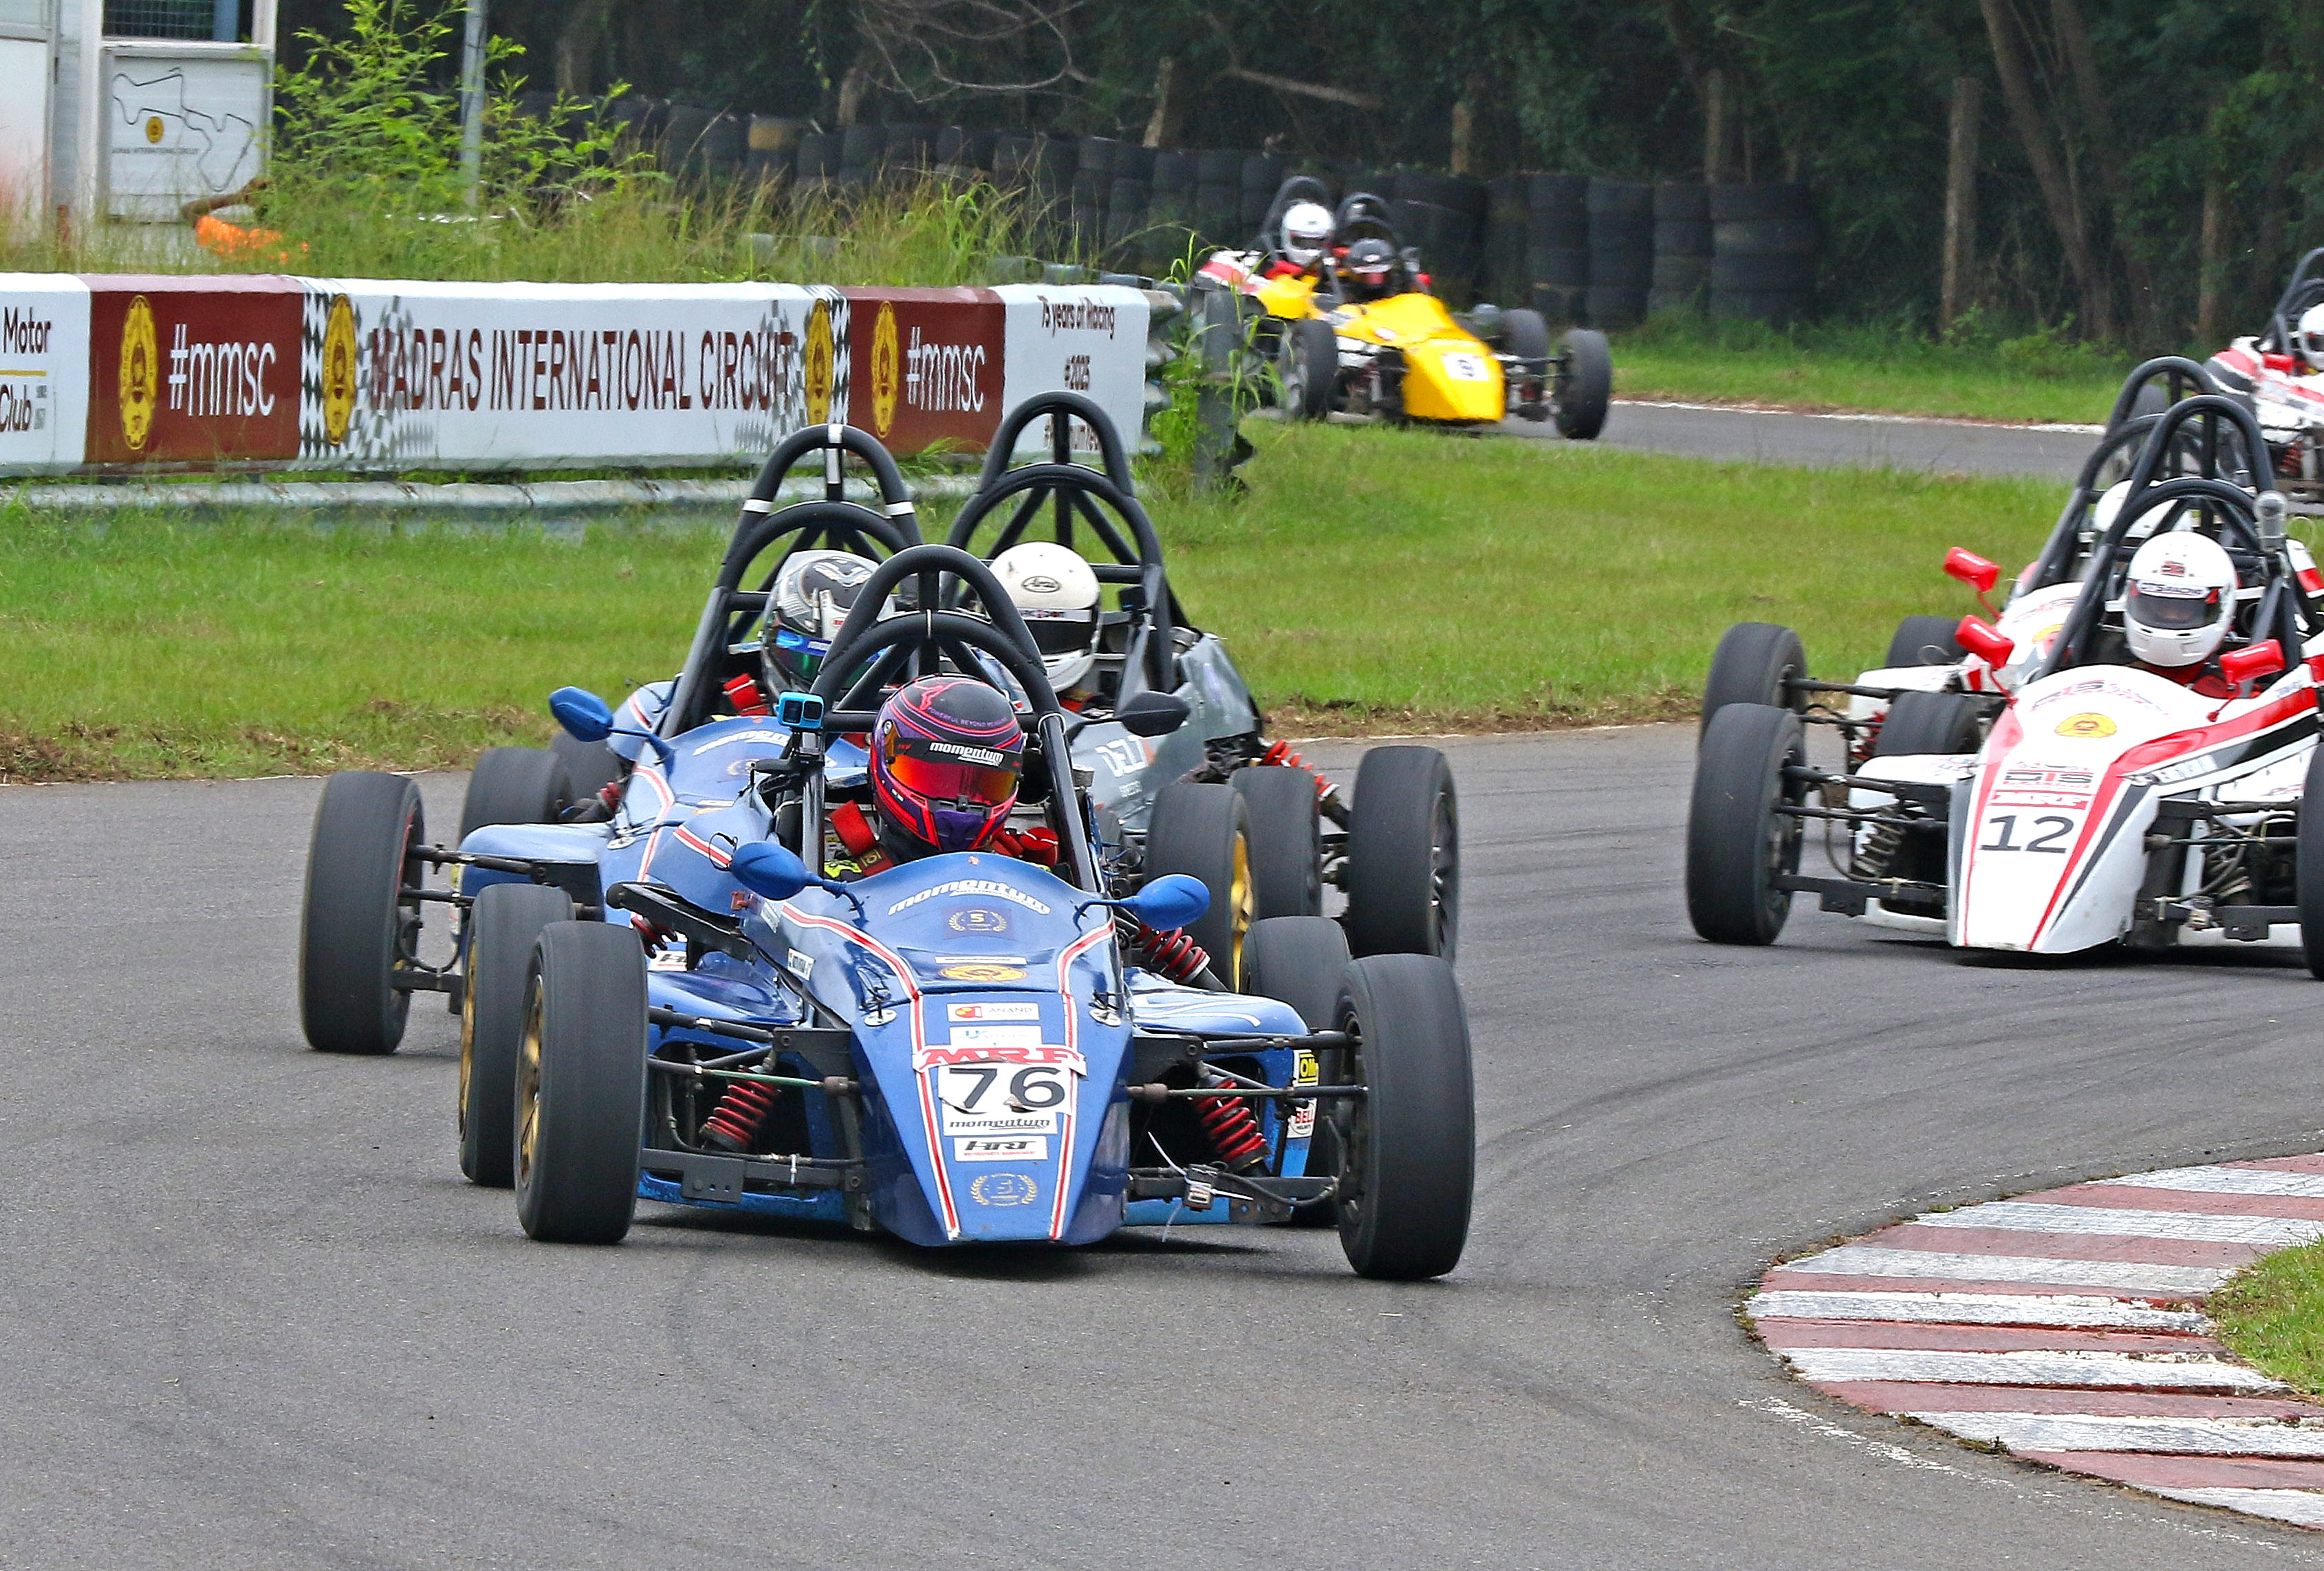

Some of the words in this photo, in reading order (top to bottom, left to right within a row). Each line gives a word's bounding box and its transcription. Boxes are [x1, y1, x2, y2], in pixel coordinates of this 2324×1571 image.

[3, 307, 51, 354] Motor
[1052, 304, 1074, 338] years
[168, 323, 276, 417] #mmsc
[370, 328, 482, 411] MADRAS
[490, 329, 692, 411] INTERNATIONAL
[700, 331, 794, 411] CIRCUIT
[906, 327, 986, 412] #mmsc
[0, 384, 32, 433] Club
[929, 742, 1005, 767] momentum
[1981, 814, 2074, 854] 12
[887, 879, 1052, 915] momentum
[919, 1047, 1080, 1070] MRF
[948, 1066, 1065, 1109] 76
[949, 1118, 1051, 1131] momentum
